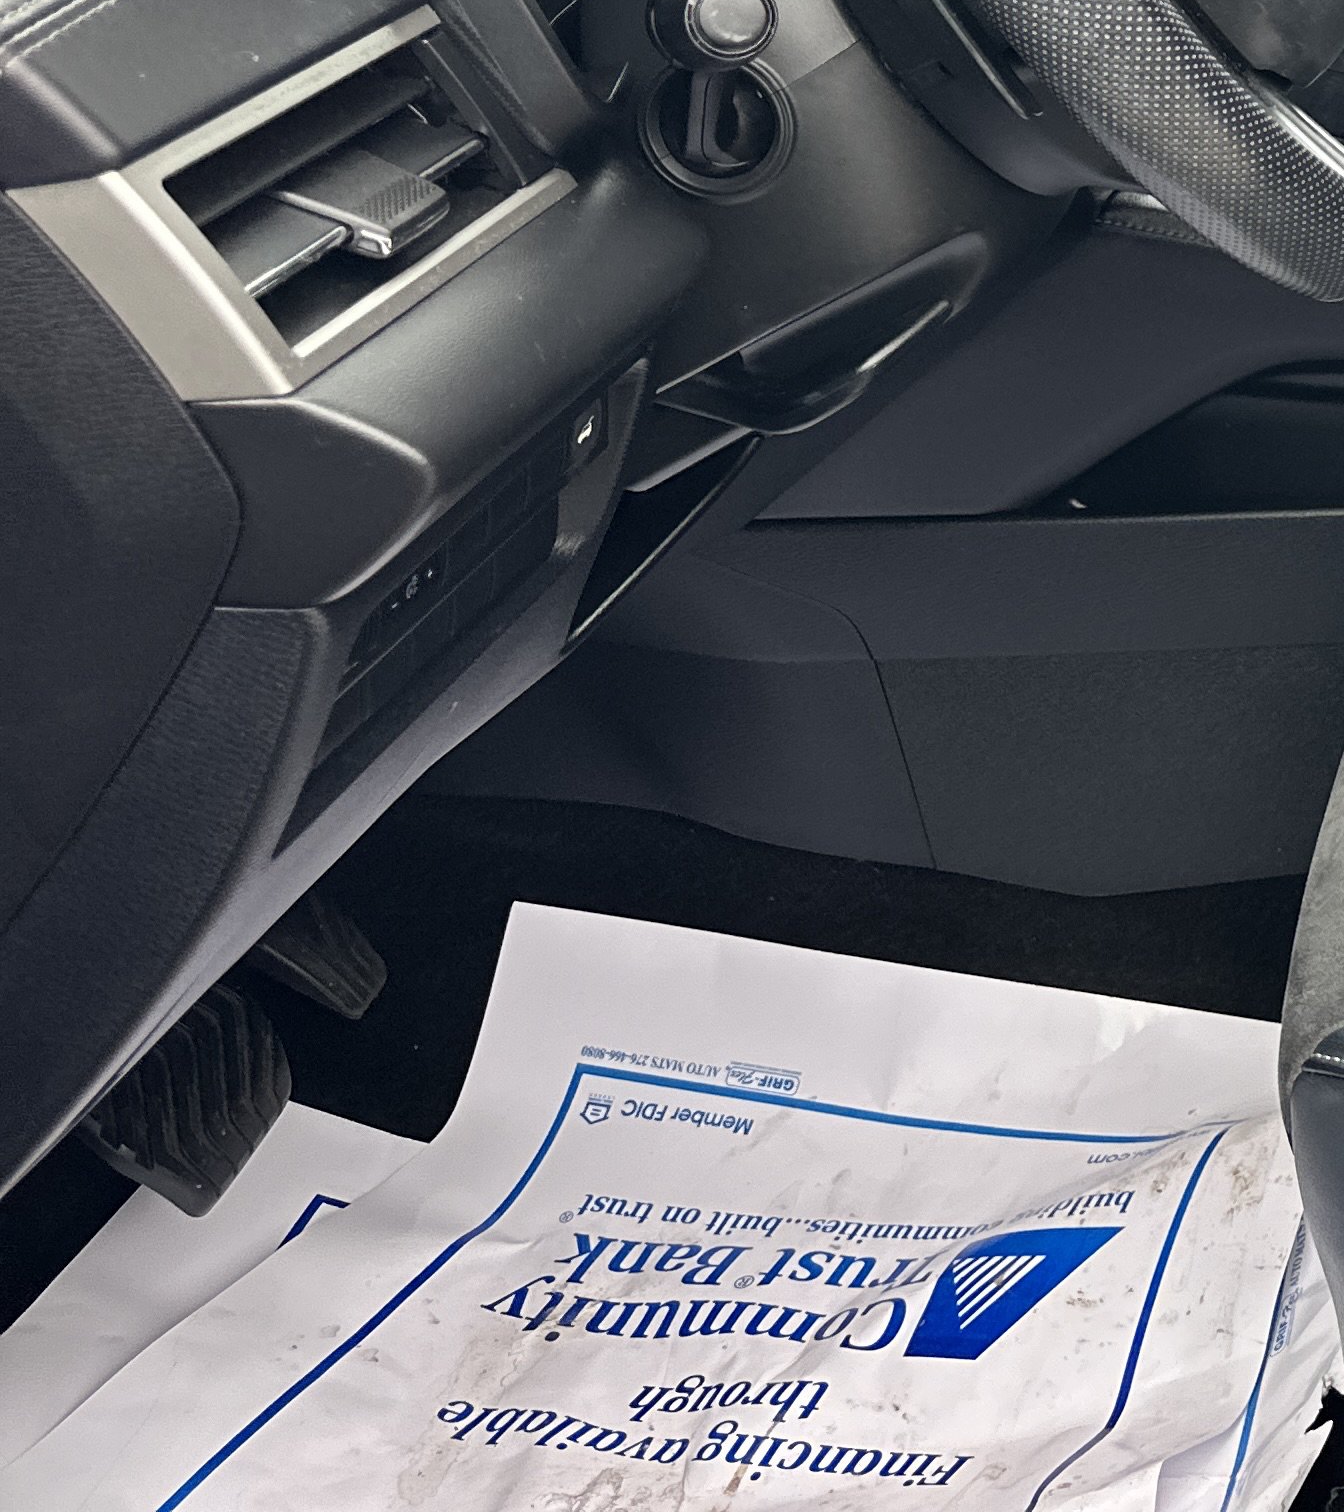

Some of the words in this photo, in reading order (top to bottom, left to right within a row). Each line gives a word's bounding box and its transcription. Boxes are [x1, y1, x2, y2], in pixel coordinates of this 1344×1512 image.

[650, 1055, 685, 1073] MATS
[685, 1063, 723, 1078] AUTO
[620, 1098, 669, 1122] FDIC
[669, 1104, 755, 1136] Member
[661, 1204, 701, 1225] on
[553, 1232, 754, 1286] Bank
[480, 1276, 907, 1354] Community
[628, 1373, 831, 1424] through
[436, 1398, 688, 1470] available
[698, 1418, 976, 1488] Financing
